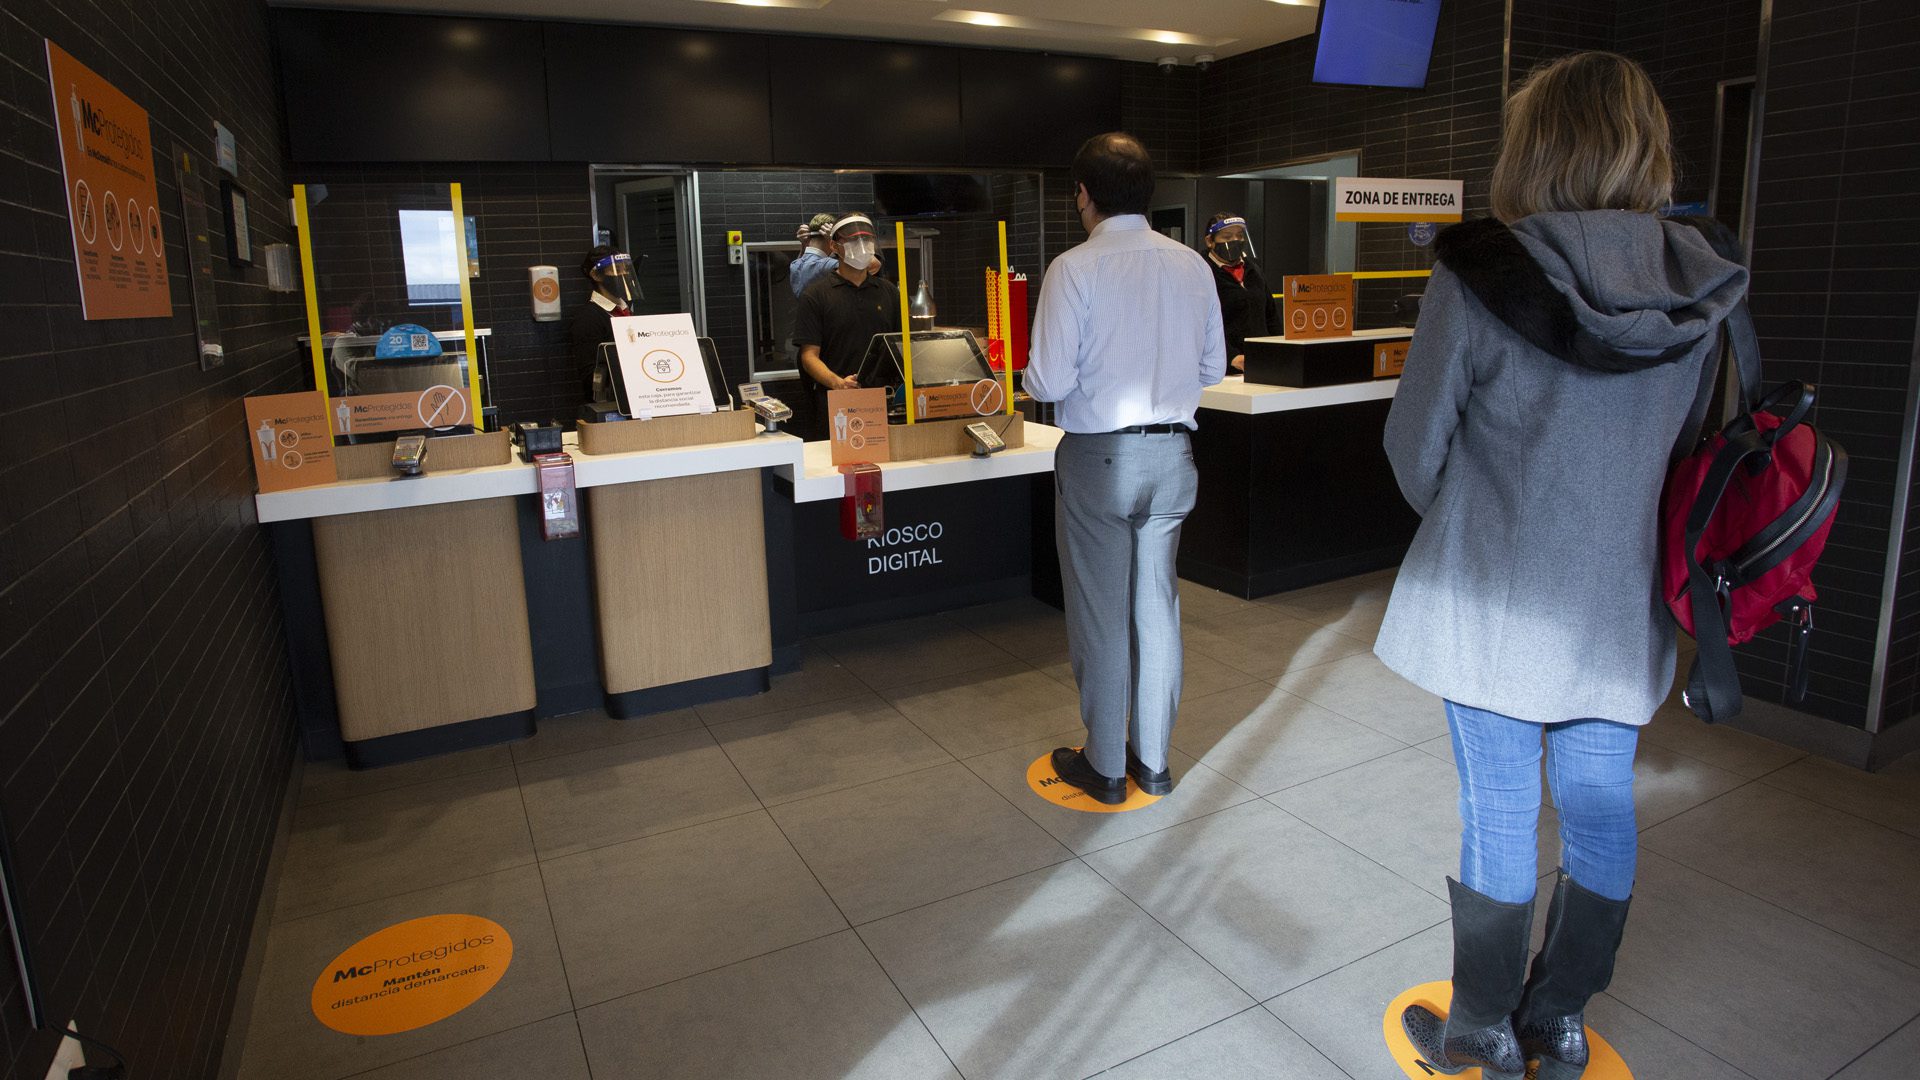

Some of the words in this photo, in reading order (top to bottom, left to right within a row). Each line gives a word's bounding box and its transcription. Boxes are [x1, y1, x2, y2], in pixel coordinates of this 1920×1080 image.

[81, 97, 144, 160] McProtegidos
[1345, 190, 1381, 205] ZONA
[1383, 191, 1399, 205] DE
[1402, 192, 1456, 207] ENTREGA
[638, 329, 690, 338] McProtegidos
[354, 401, 413, 414] McProtegidos
[868, 521, 943, 549] KIOSCO
[868, 547, 943, 575] DIGITAL
[333, 934, 495, 984] McProtegidos
[330, 985, 401, 1010] distancia
[404, 962, 490, 991] demarcada.
[382, 966, 442, 988] Mantén
